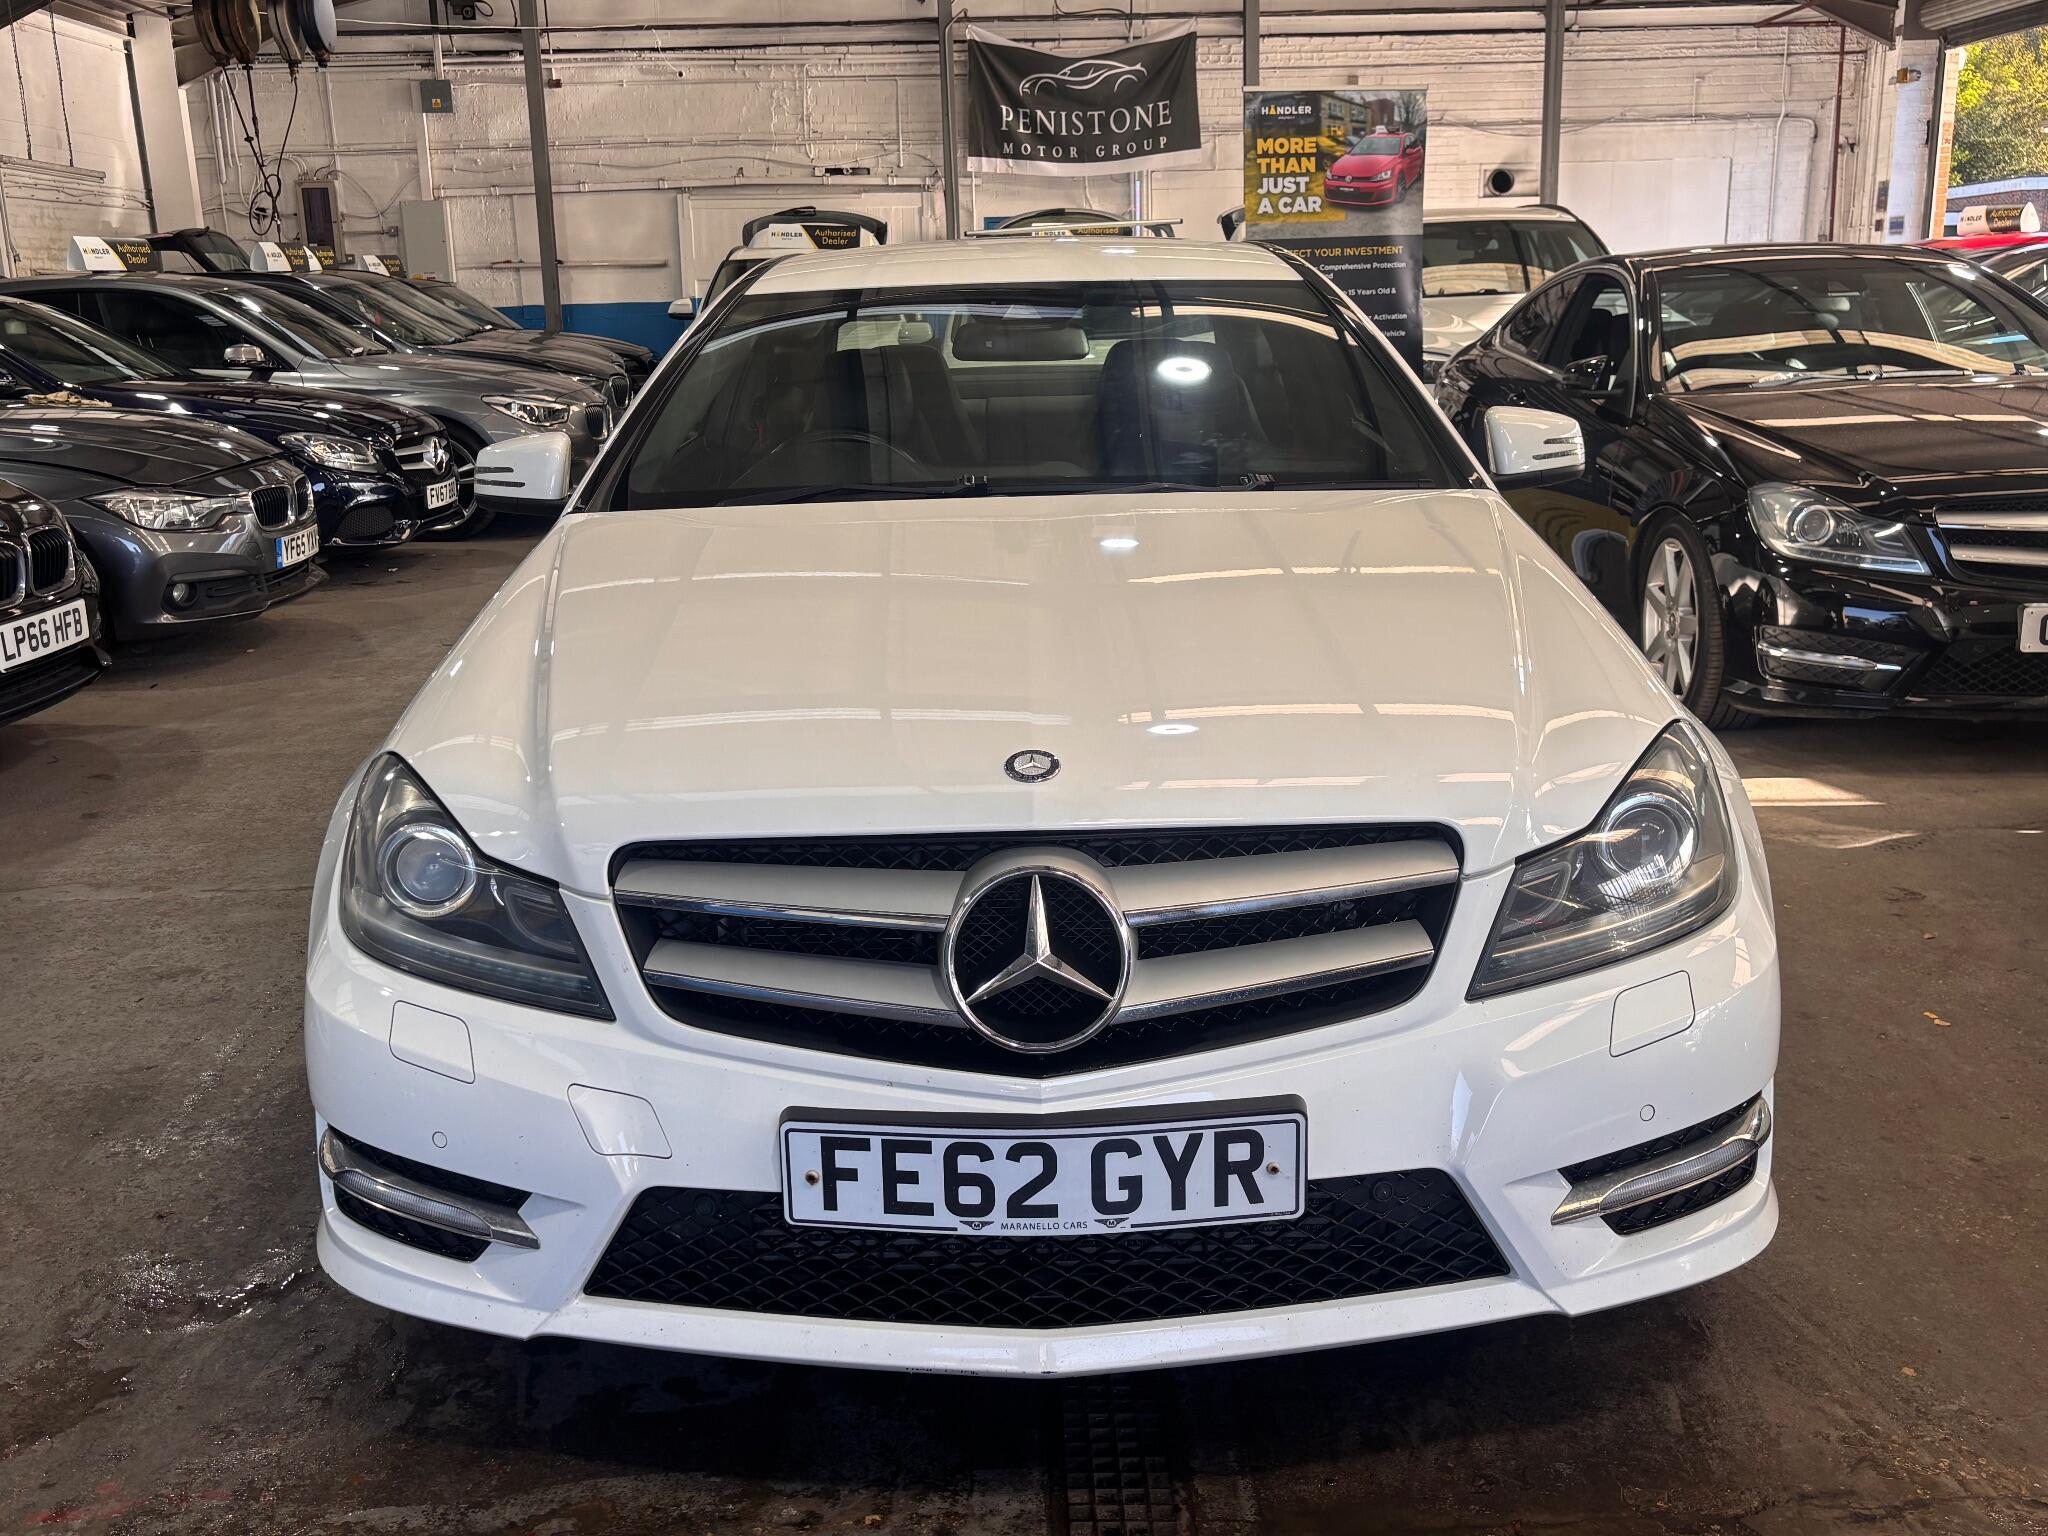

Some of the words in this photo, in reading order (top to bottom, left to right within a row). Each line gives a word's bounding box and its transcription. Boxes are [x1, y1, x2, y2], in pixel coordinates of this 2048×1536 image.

[999, 100, 1172, 136] PENISTONE
[1002, 142, 1079, 158] MOTOR
[1095, 136, 1168, 157] GROUP
[1256, 136, 1317, 154] MORE
[1256, 157, 1316, 174] THAN
[1256, 176, 1310, 194] JUST
[1256, 197, 1273, 214] A
[1278, 196, 1322, 213] CAR
[814, 228, 857, 238] Authorised
[1076, 226, 1119, 236] Authorised
[822, 237, 849, 245] Dealer
[116, 243, 151, 254] Authorised
[1314, 247, 1342, 257] YOUR
[1343, 245, 1404, 256] INVESTMENT
[126, 253, 148, 264] Dealer
[1319, 263, 1372, 271] Comprehensive
[1372, 261, 1407, 269] Protection
[1348, 288, 1356, 296] 15
[1357, 288, 1377, 296] Years
[1377, 287, 1390, 295] Old
[1373, 312, 1408, 320] Activation
[283, 533, 306, 561] YF65
[0, 618, 51, 662] LP66
[52, 607, 83, 645] HFB
[819, 1135, 1059, 1218] FE62
[1090, 1128, 1265, 1215] GYR
[1000, 1222, 1060, 1230] MARANELLO
[1063, 1221, 1088, 1229] CARS
